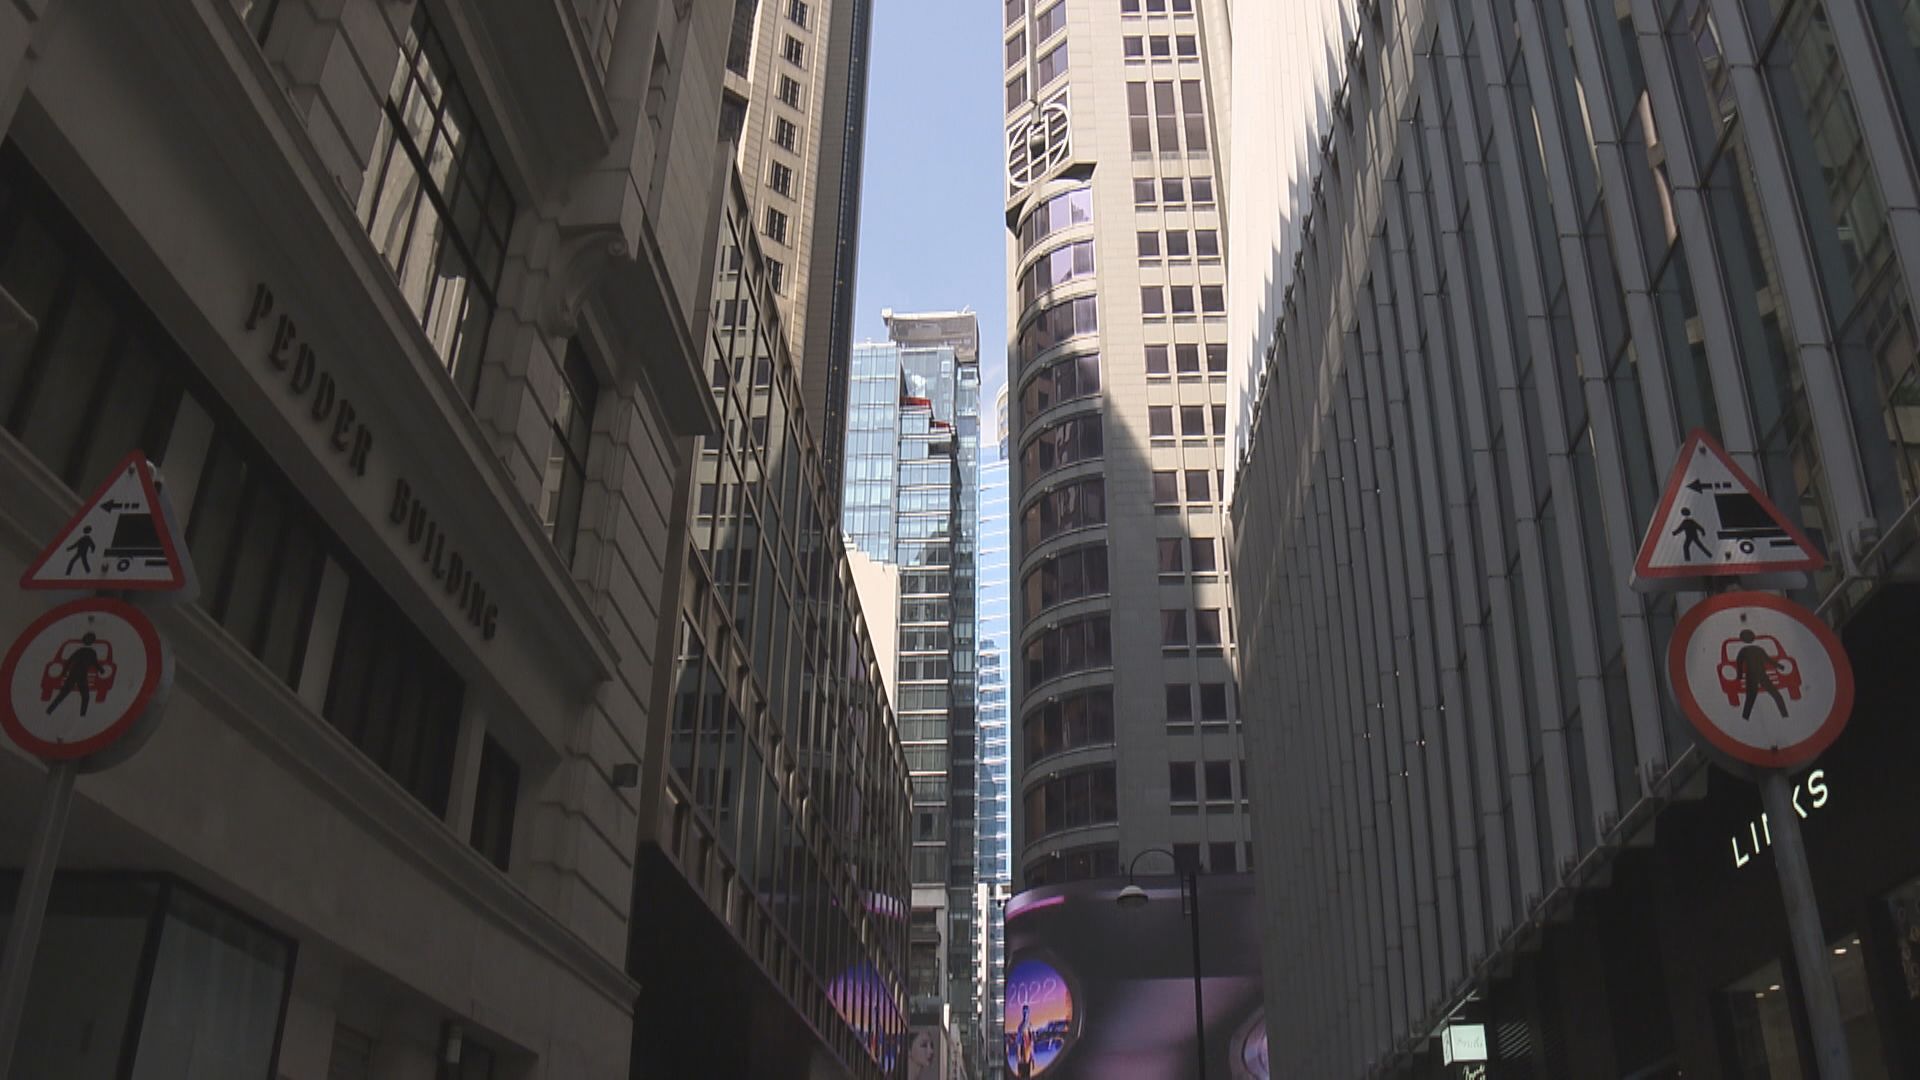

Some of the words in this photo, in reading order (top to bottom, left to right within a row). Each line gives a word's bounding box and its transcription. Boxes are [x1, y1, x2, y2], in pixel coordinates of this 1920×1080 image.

[245, 282, 373, 477] PEDDER
[390, 477, 498, 641] BUILDING
[1008, 977, 1057, 1008] 2022
